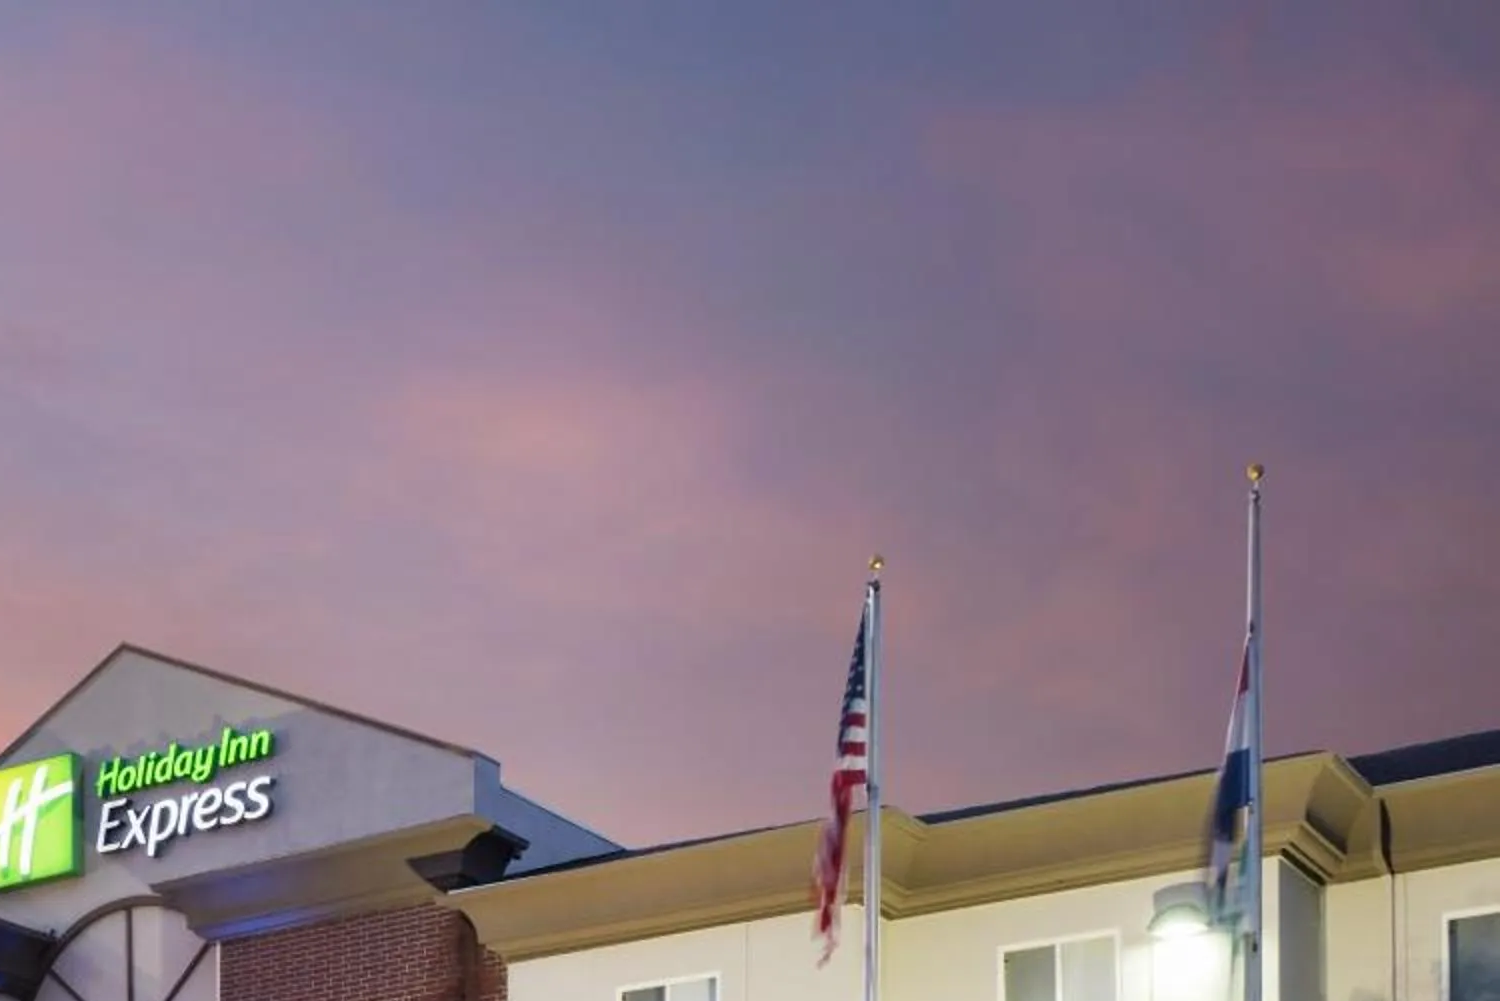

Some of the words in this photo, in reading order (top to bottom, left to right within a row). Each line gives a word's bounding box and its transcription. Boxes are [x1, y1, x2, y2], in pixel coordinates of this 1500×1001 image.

[97, 743, 214, 797] Holiday
[219, 727, 271, 766] Inn
[97, 776, 270, 856] Express
